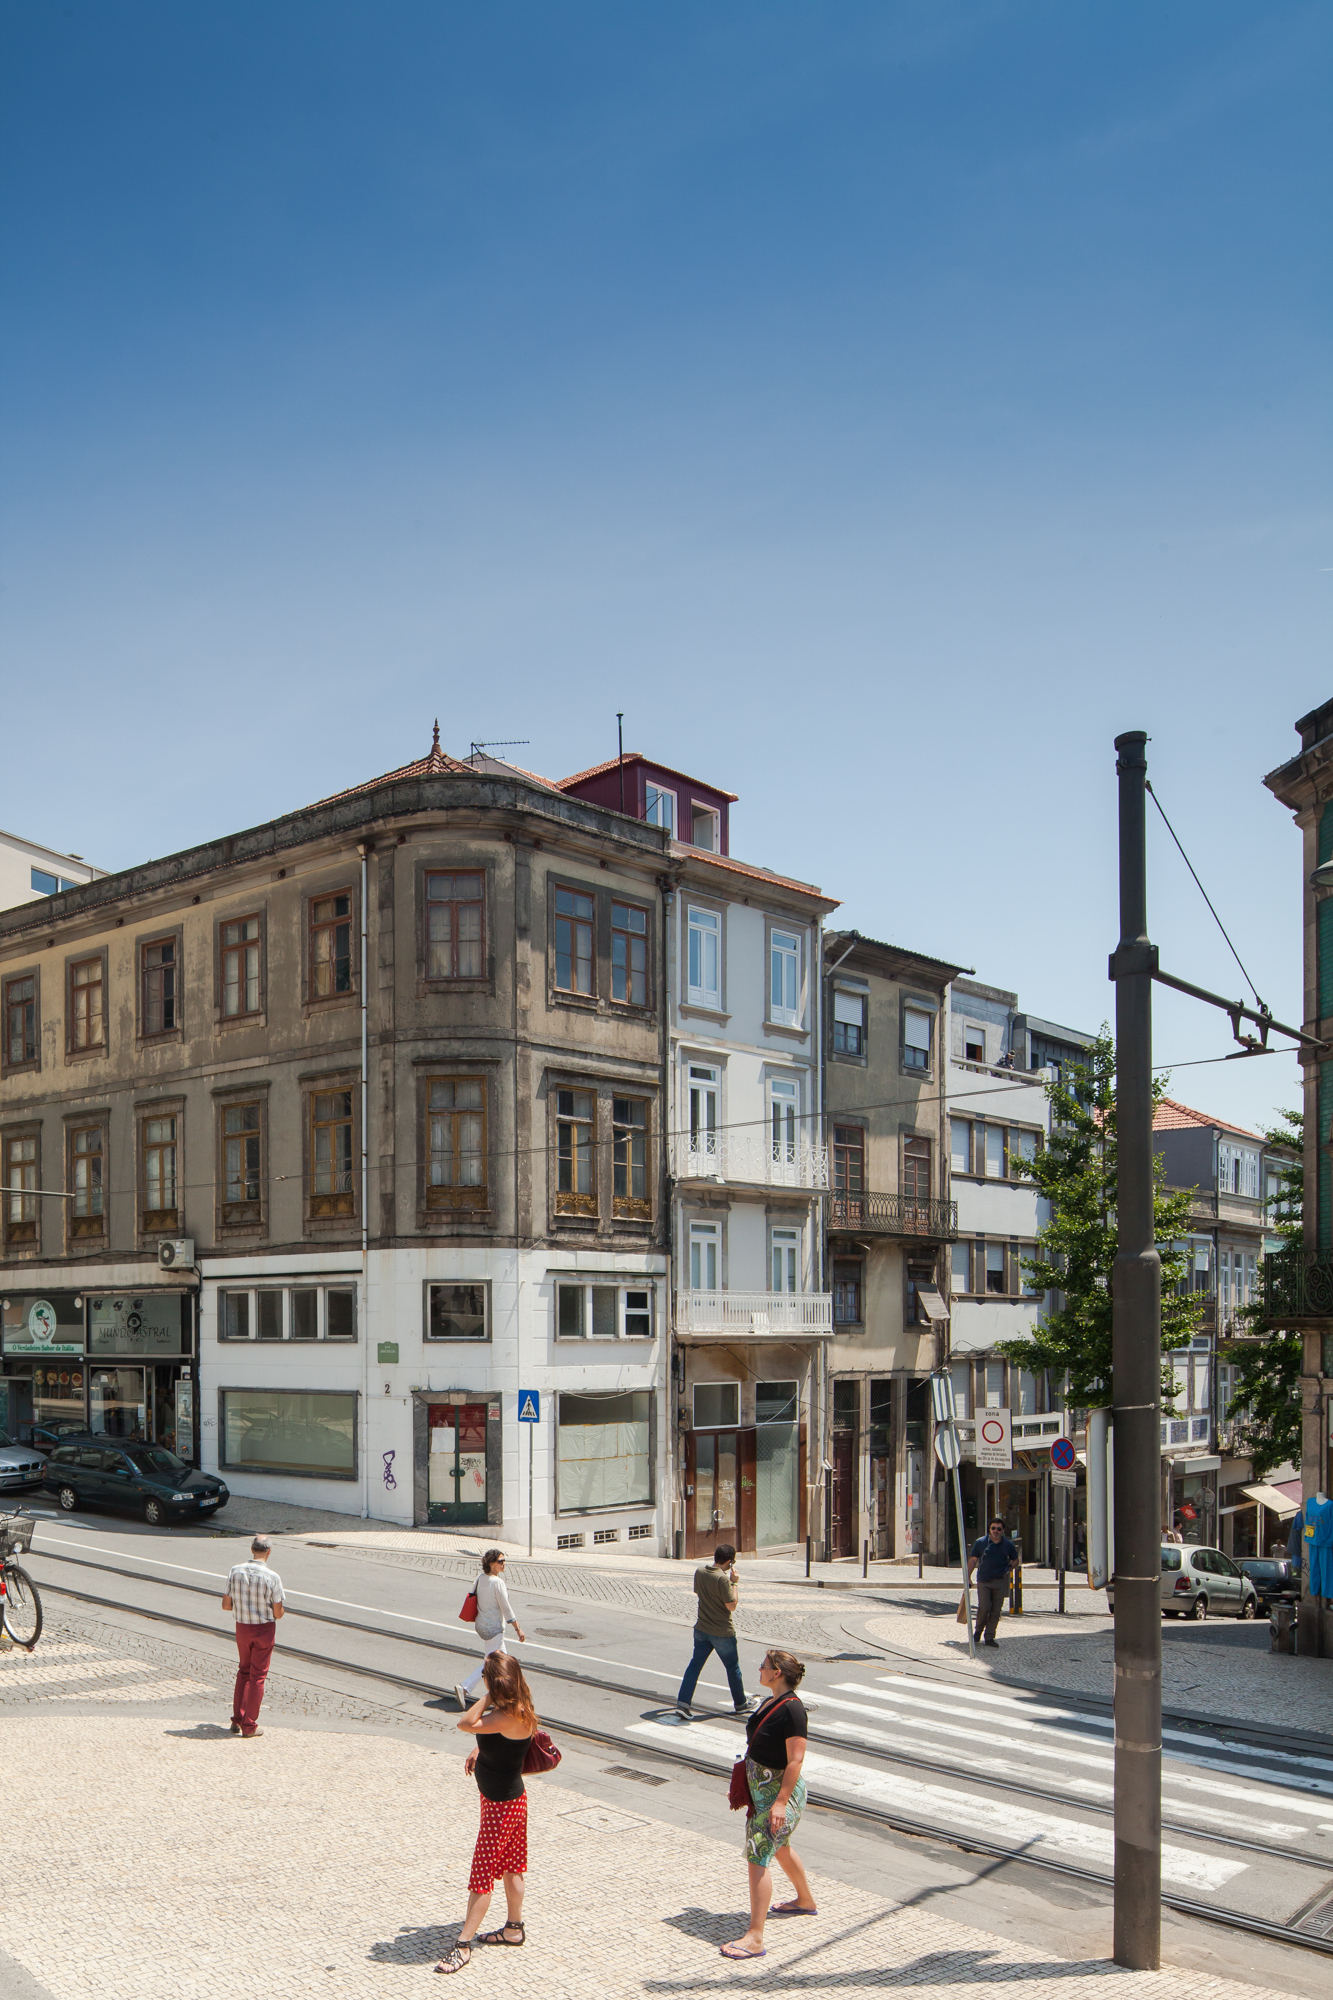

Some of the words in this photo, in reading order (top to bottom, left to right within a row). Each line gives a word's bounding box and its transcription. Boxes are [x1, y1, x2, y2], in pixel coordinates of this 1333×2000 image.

[99, 1327, 134, 1338] MUNDO
[136, 1326, 171, 1338] ASTRAL
[384, 1383, 391, 1394] 2
